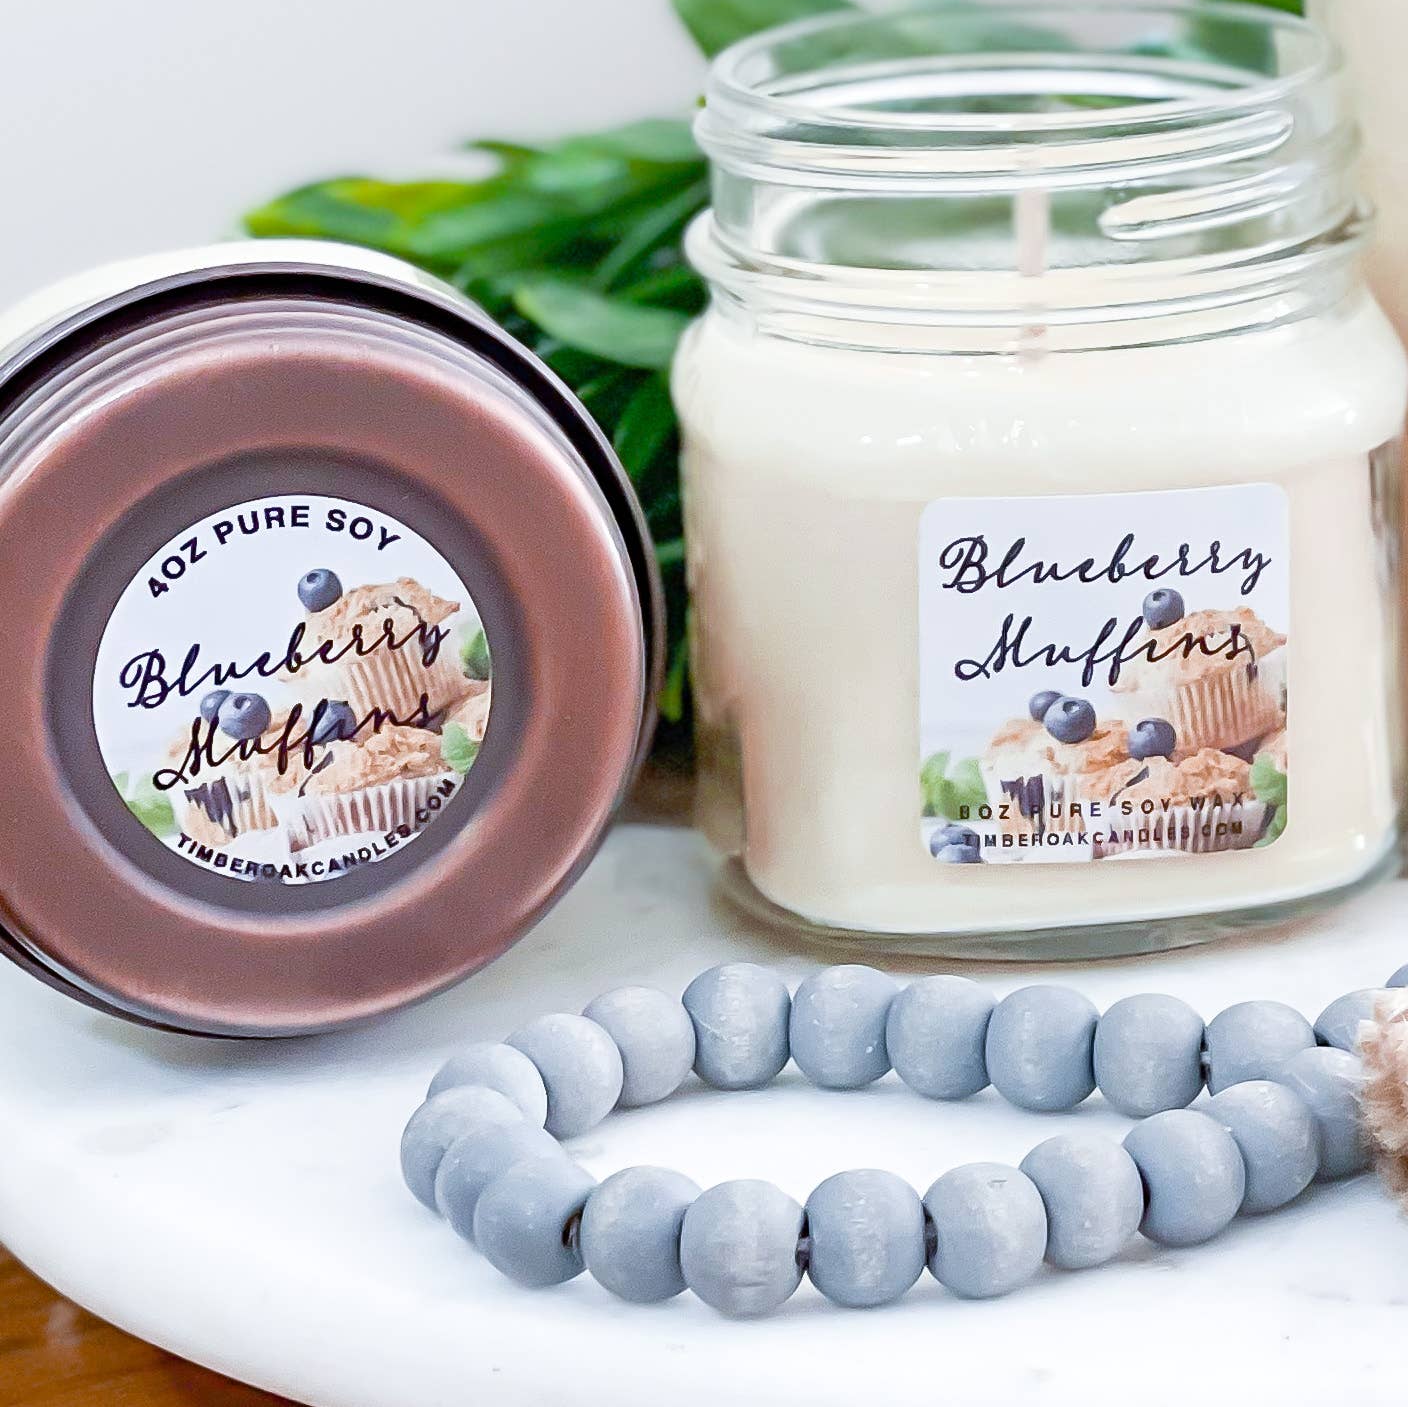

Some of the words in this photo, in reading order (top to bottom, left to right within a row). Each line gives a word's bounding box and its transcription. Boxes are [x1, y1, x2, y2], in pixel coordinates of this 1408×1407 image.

[147, 537, 208, 599] 4OZ
[212, 504, 311, 546] PURE
[325, 508, 401, 551] SOY
[939, 532, 1273, 596] Blueberry
[119, 617, 452, 710] Blueberry
[954, 613, 1252, 687] Muffins
[152, 693, 443, 792] Muffins
[176, 777, 458, 880] TIMBEROAKCANDLES.COM
[1029, 801, 1102, 821] PURE
[1120, 797, 1172, 816] SOY
[1190, 791, 1245, 812] WAX
